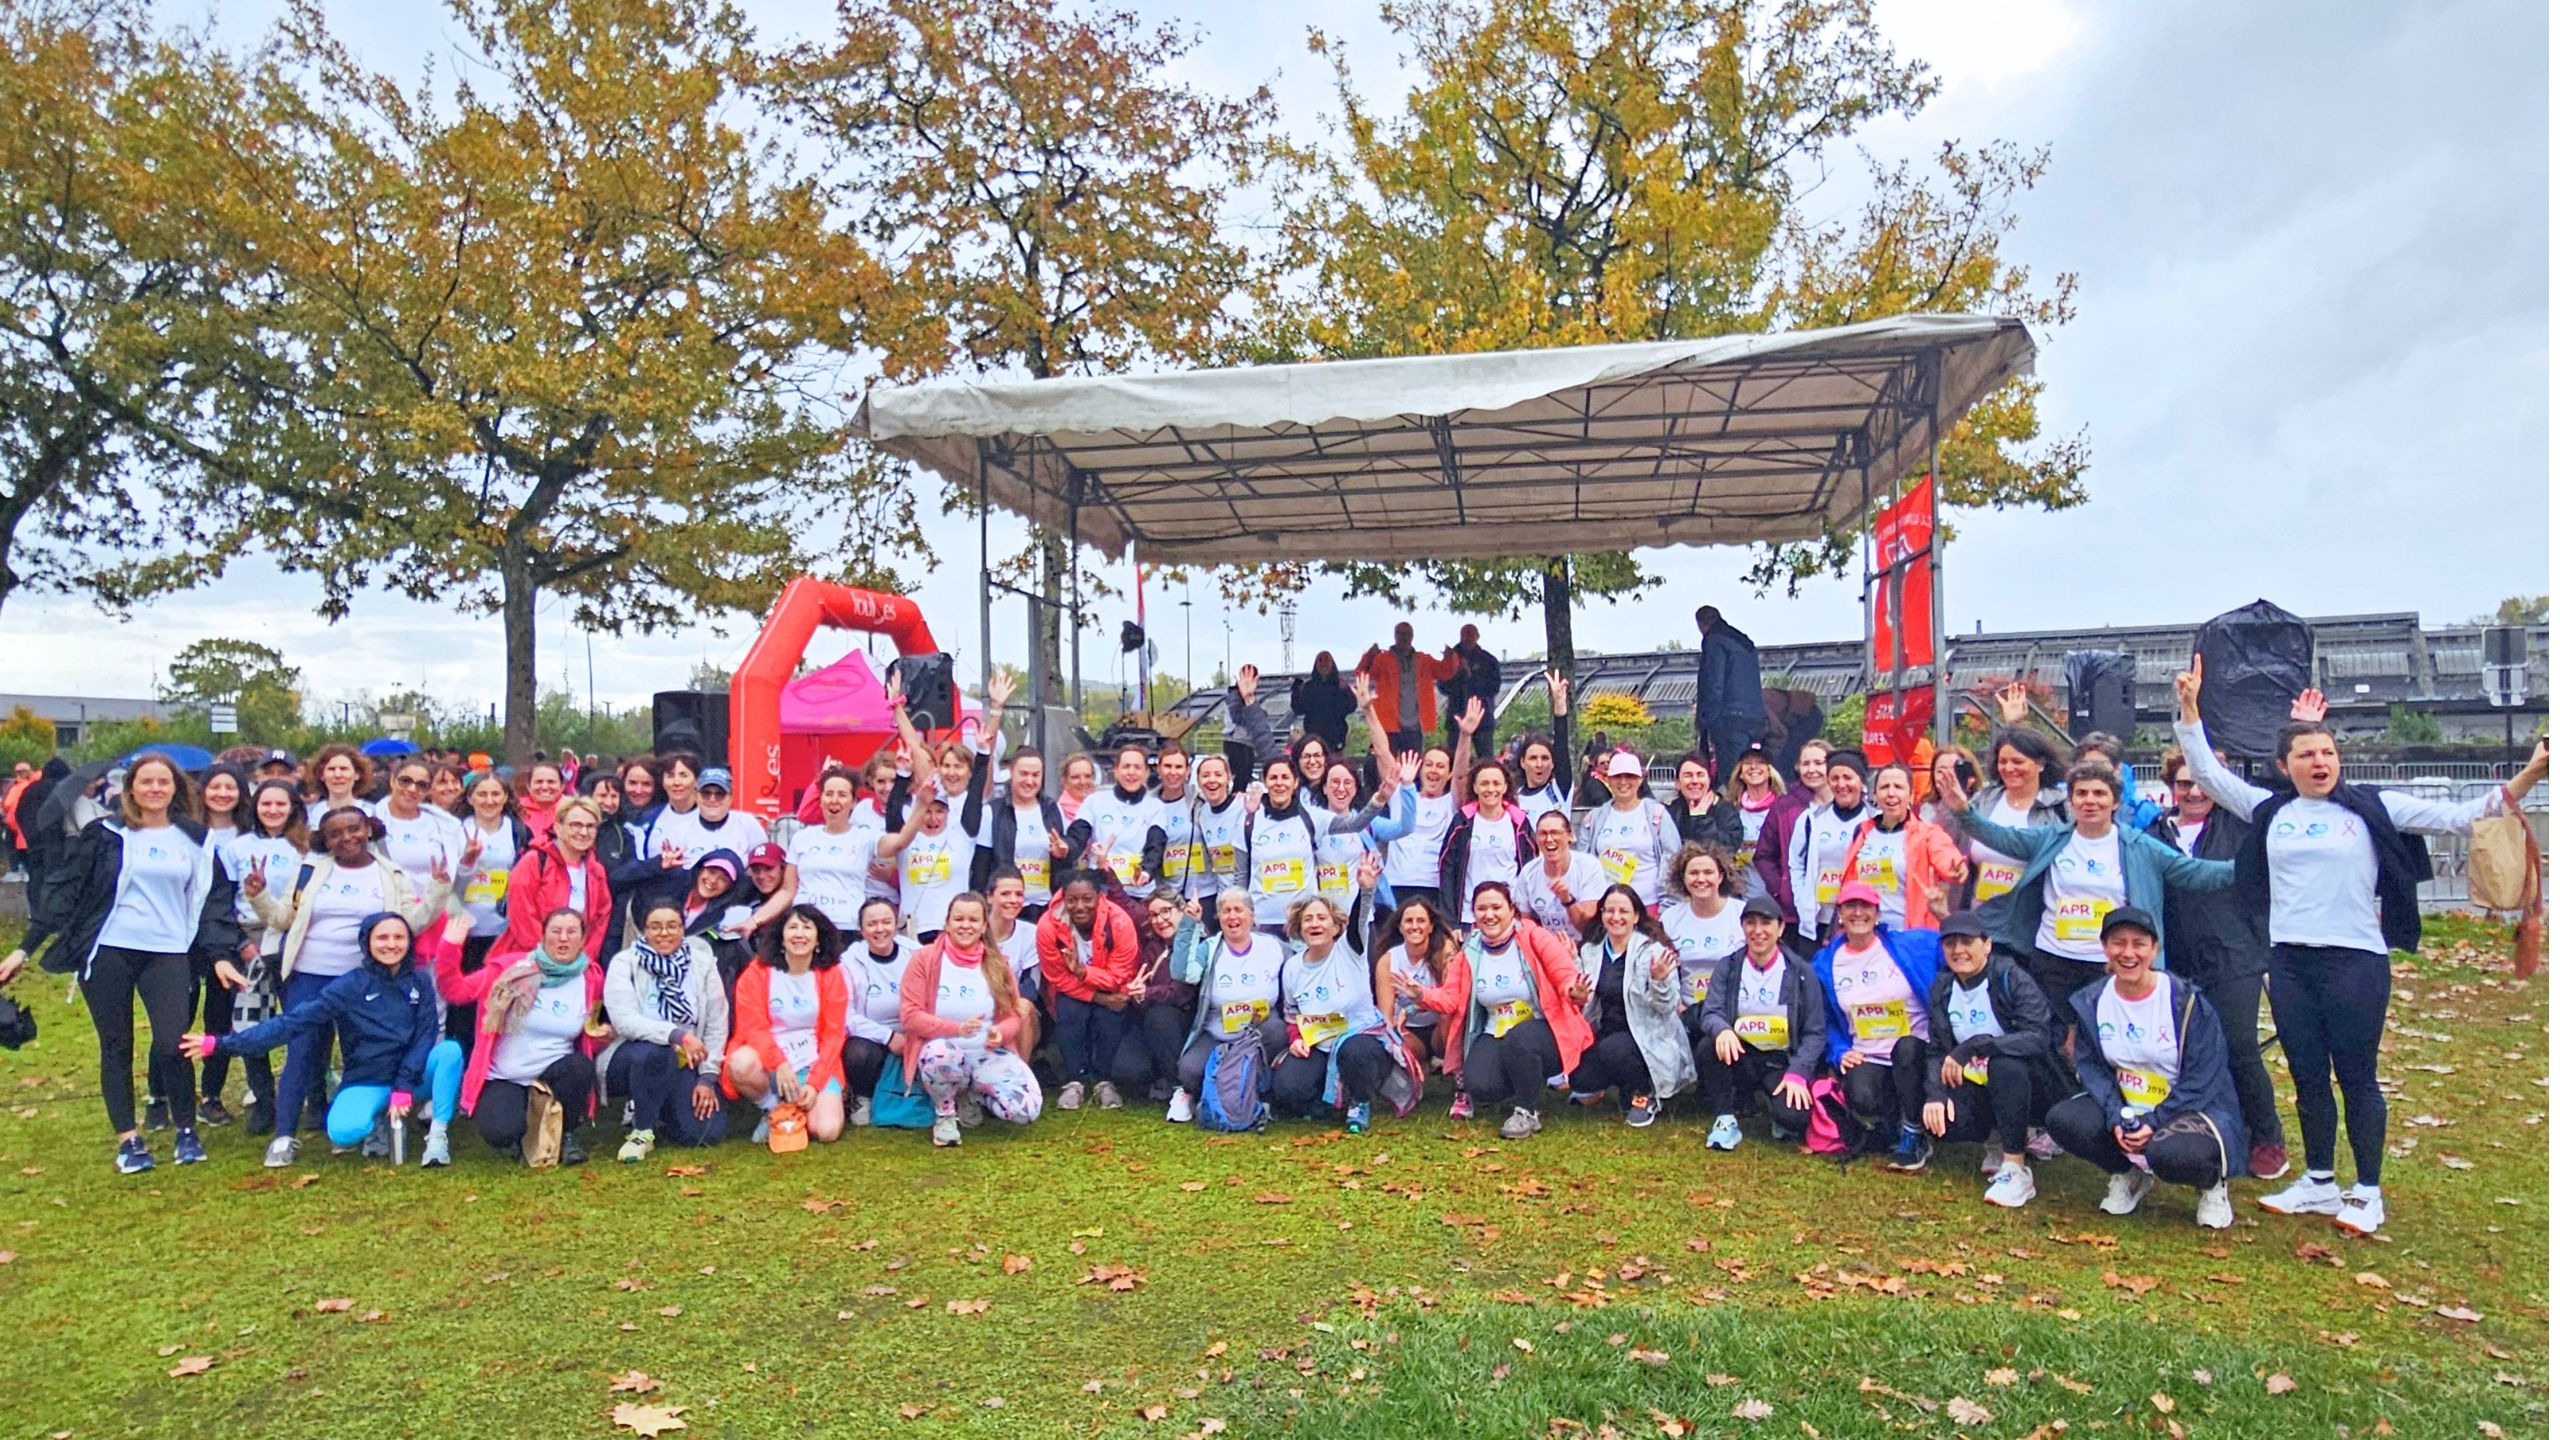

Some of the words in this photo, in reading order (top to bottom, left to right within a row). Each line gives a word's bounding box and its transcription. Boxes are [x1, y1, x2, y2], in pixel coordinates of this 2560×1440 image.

[910, 854, 934, 865] APR
[1602, 848, 1625, 864] APR
[1263, 862, 1289, 875] APR
[1859, 863, 1881, 875] APR
[1984, 868, 2015, 882] APR
[2060, 903, 2091, 916] APR
[1857, 1005, 1885, 1018] APR
[1302, 1015, 1327, 1026] APR
[1738, 1021, 1767, 1033] APR
